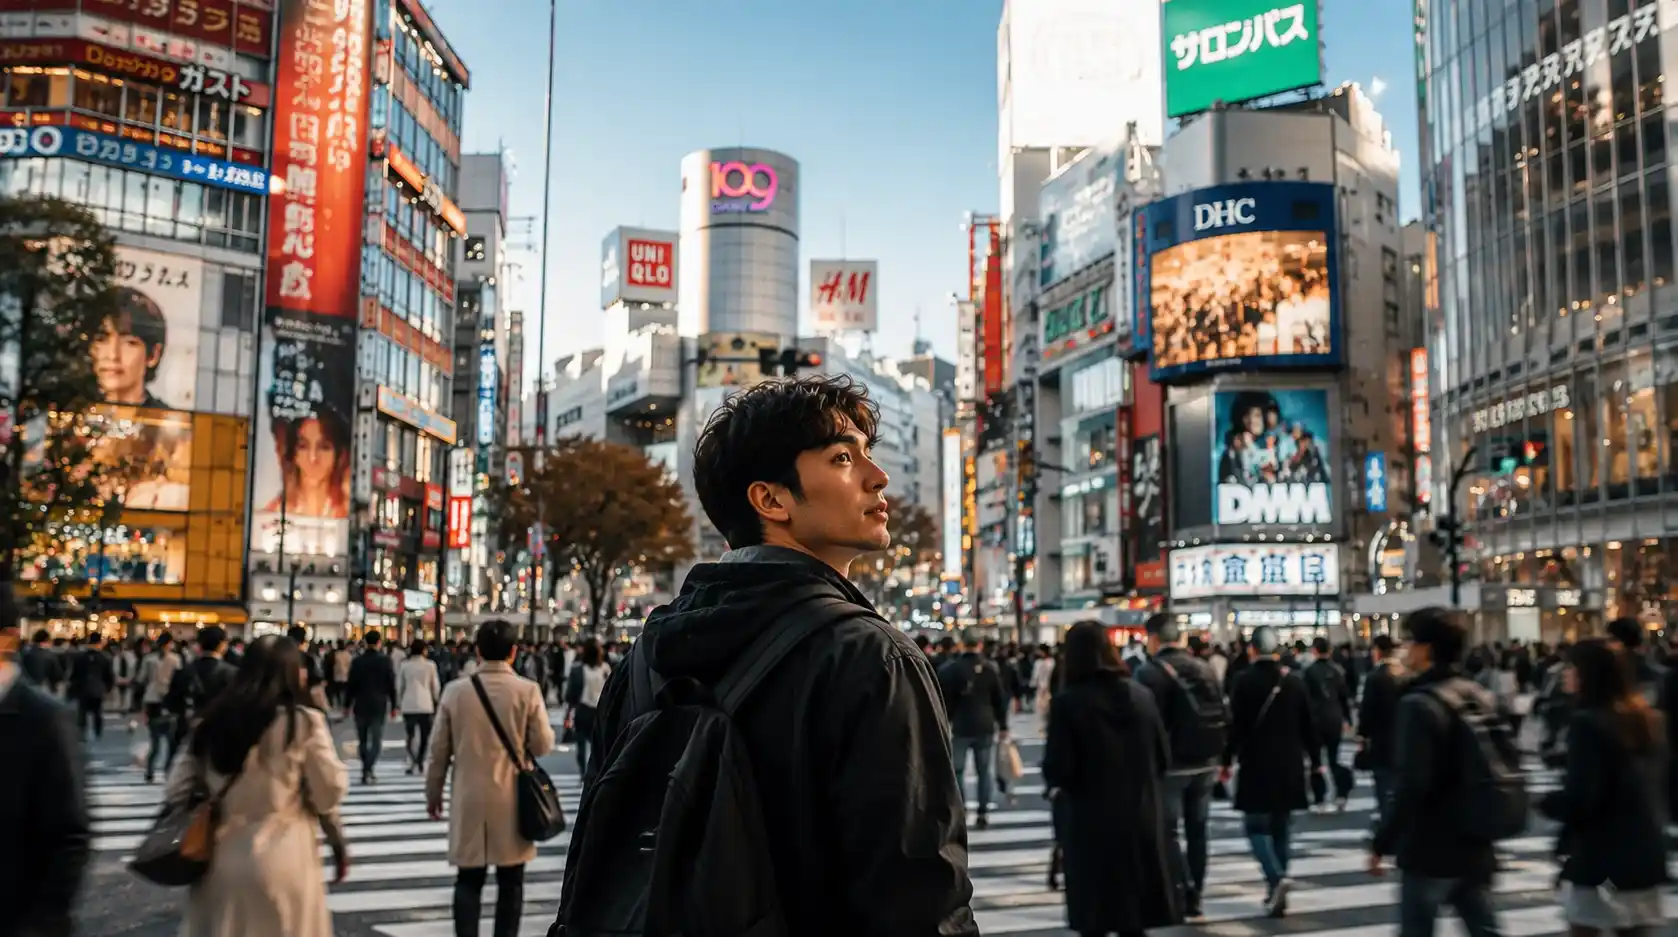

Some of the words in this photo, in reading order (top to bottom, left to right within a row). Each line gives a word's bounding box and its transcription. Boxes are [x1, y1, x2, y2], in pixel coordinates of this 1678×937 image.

[1171, 4, 1309, 70] サロンパス
[179, 65, 251, 101] ガスト
[708, 161, 778, 211] 109
[1193, 198, 1256, 231] DHC
[631, 243, 665, 264] UNI
[631, 263, 669, 284] QLO
[1218, 482, 1332, 524] DMM
